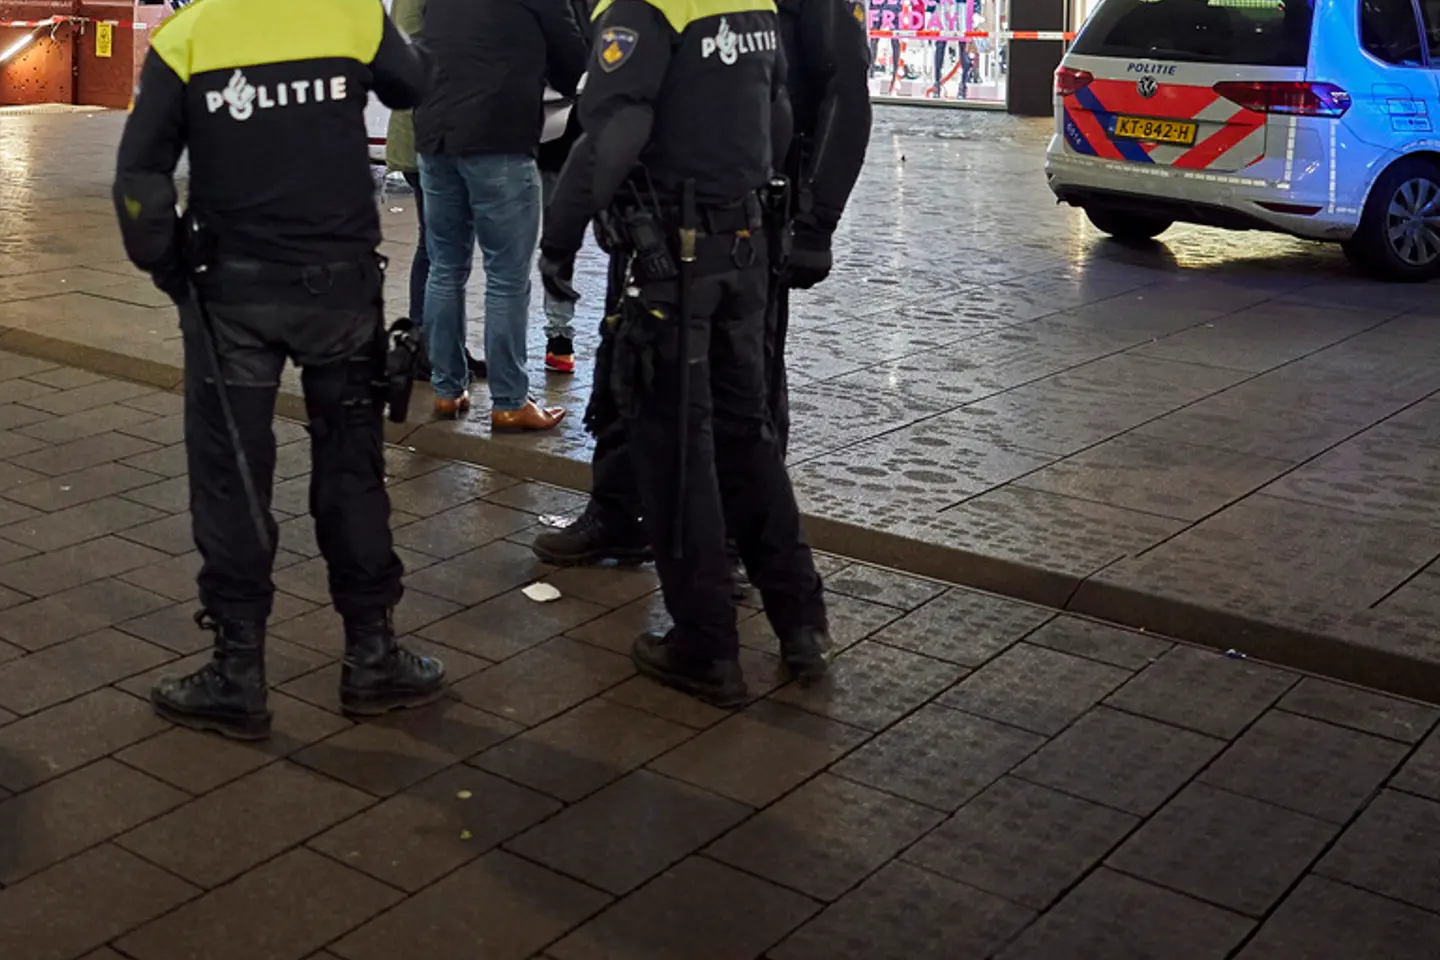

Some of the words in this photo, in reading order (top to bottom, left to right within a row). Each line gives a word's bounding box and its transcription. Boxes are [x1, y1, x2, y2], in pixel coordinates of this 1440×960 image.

[867, 8, 959, 31] FRIDAY
[1127, 62, 1177, 76] POLITIE
[205, 69, 348, 121] POLITIE
[1119, 120, 1190, 140] KT-842-H
